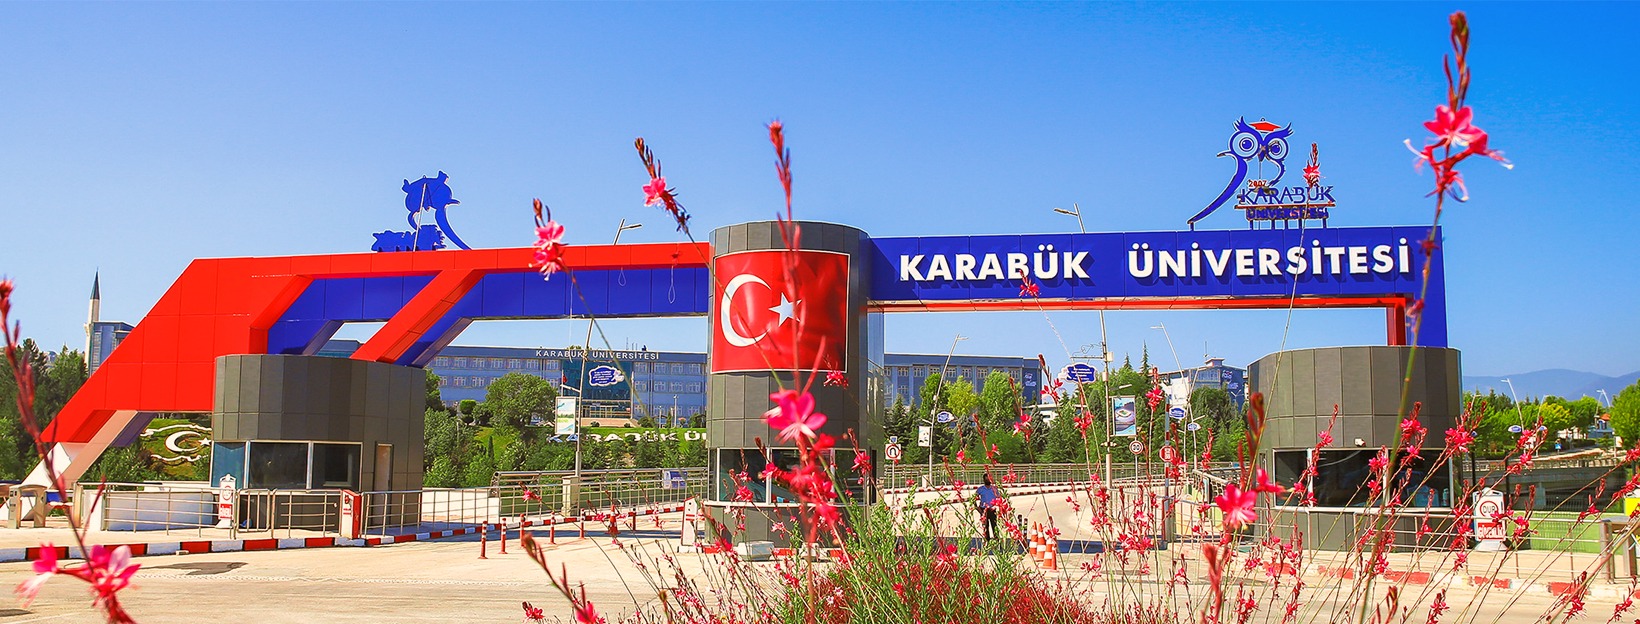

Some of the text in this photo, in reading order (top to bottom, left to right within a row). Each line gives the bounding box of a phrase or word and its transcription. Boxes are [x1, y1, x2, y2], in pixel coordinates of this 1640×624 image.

[900, 237, 1410, 281] KARABÜK ÜNİVERSİTESİ
[592, 351, 660, 360] ÜNİVERSİTESİ
